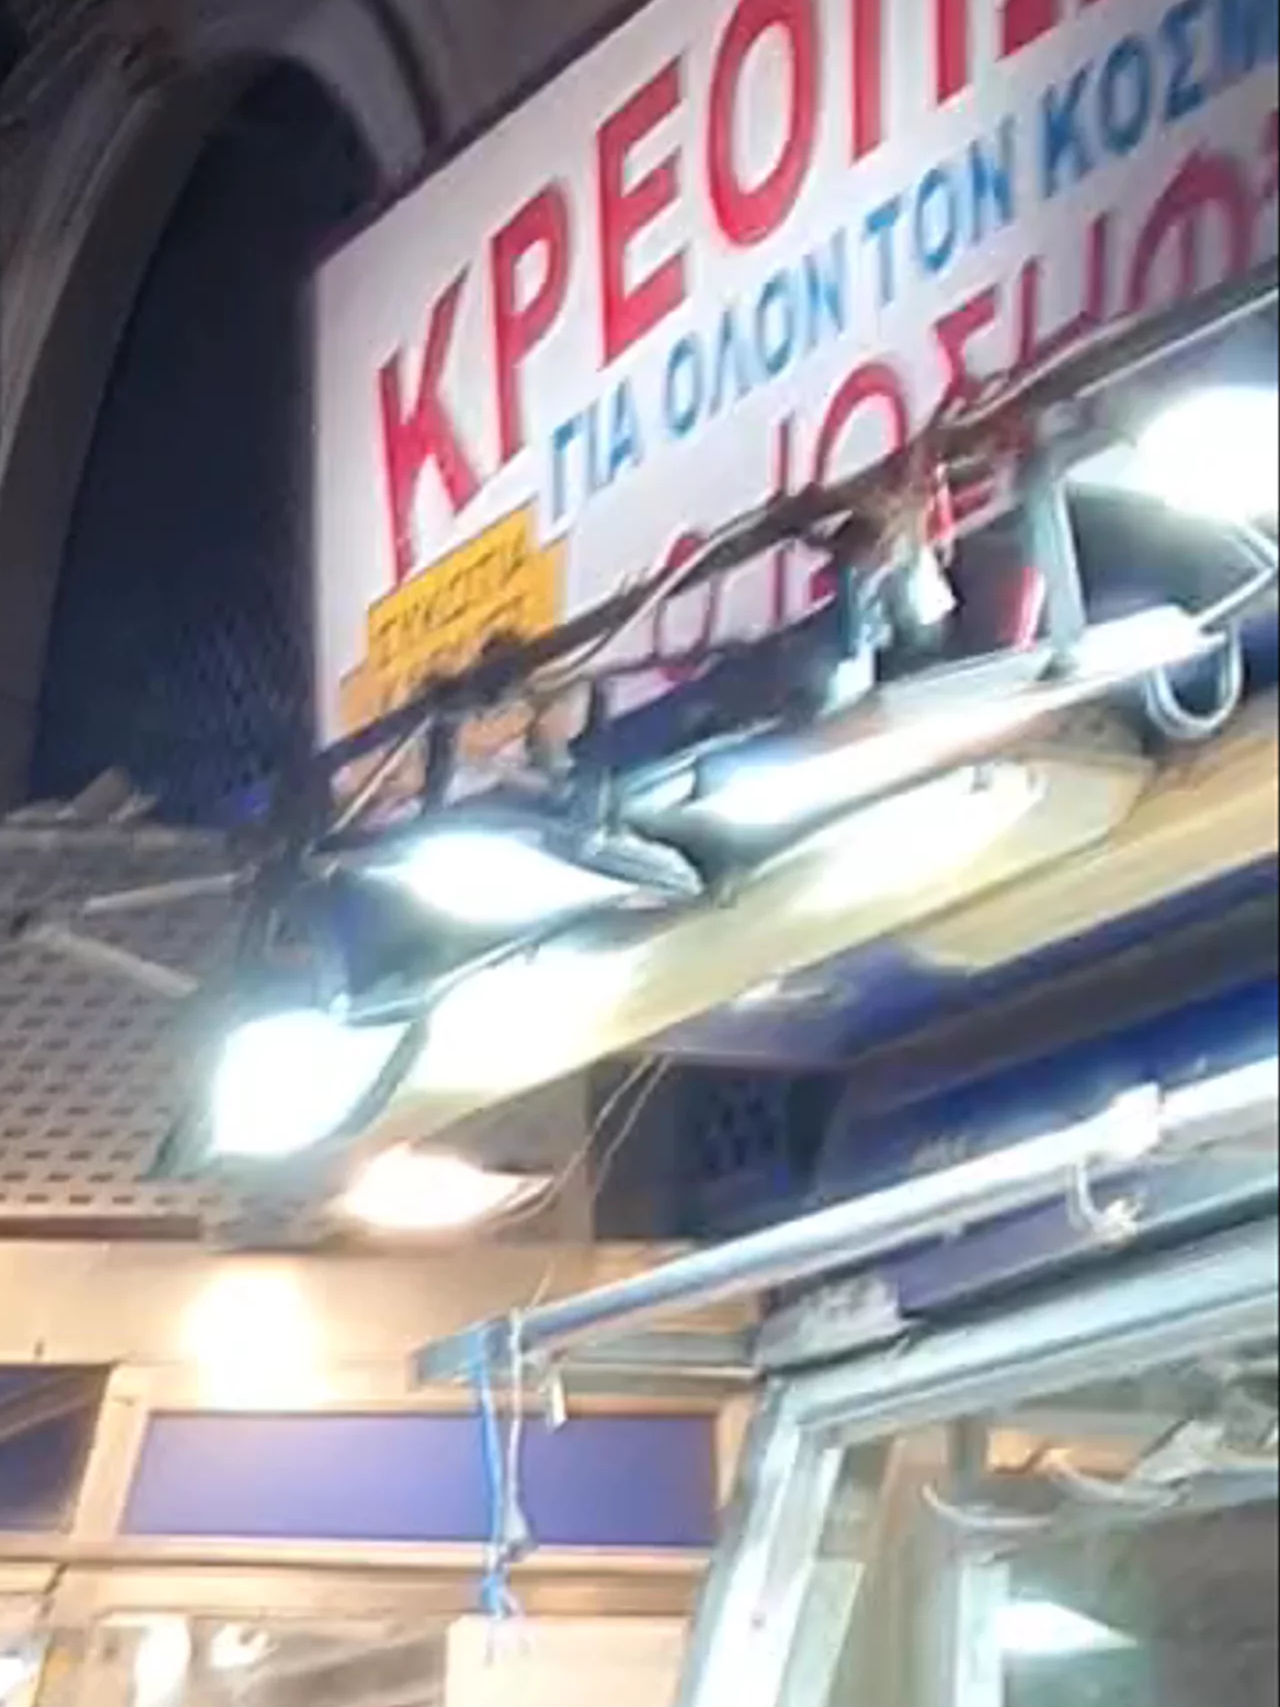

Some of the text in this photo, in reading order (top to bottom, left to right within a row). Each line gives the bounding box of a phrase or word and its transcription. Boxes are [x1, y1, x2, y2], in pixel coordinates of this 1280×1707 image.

[552, 379, 639, 523] ΓΙΑ
[665, 229, 844, 436] ΟΛΟΝ
[864, 118, 1014, 301] ΤΟΝ
